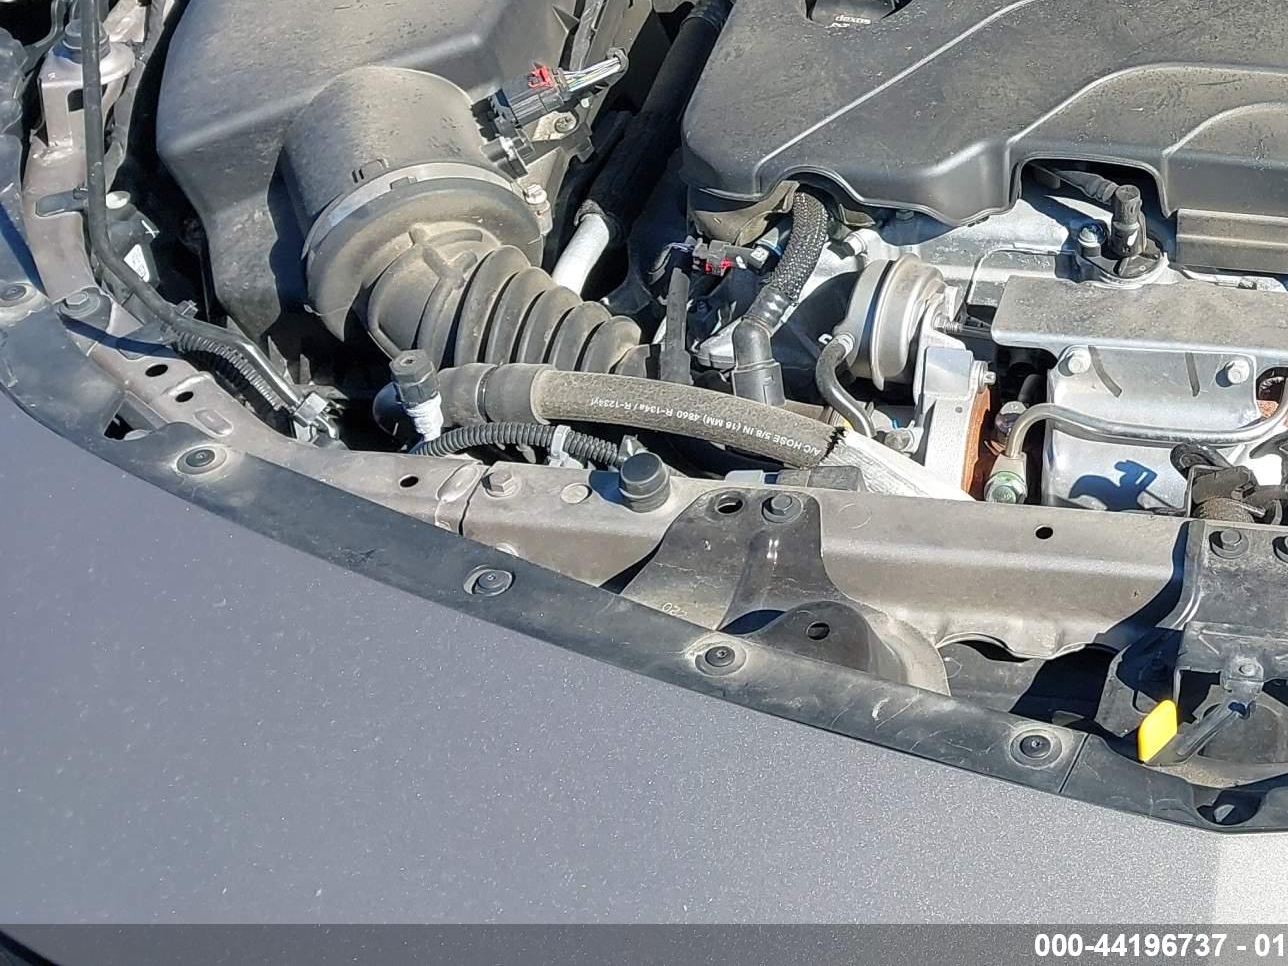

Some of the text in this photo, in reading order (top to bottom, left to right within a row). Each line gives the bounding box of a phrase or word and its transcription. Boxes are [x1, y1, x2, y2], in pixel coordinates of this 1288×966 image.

[702, 414, 724, 427] MM)
[772, 435, 801, 450] HOSE
[803, 444, 822, 456] A/C
